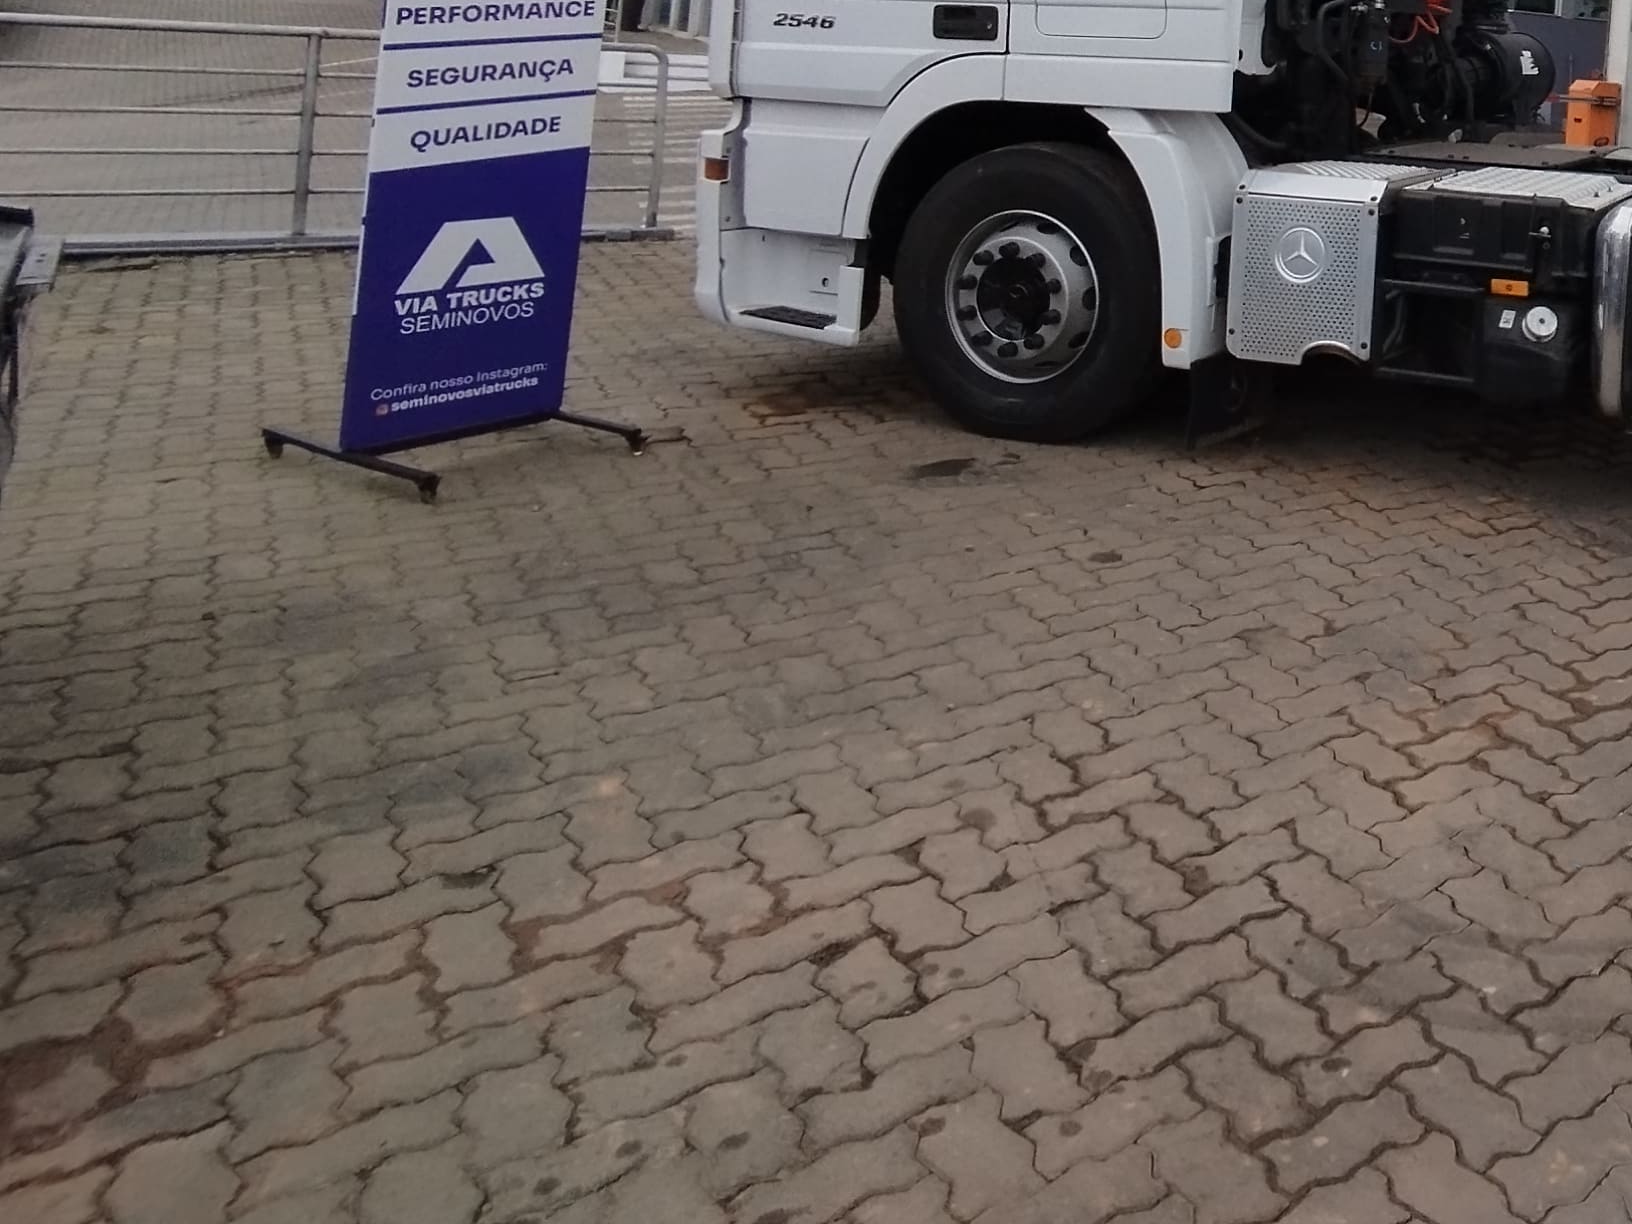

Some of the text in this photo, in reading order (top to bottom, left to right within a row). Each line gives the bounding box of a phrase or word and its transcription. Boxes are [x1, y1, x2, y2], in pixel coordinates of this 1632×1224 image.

[396, 0, 596, 26] PERFORMANCE
[773, 12, 836, 30] 2546
[407, 58, 575, 88] SEGURANÇA
[410, 116, 562, 153] QUALIDADE
[394, 282, 546, 317] VIA TRUCKS
[399, 301, 535, 335] SEMINOVOS
[370, 362, 549, 401] Confira nosso Instagram:
[391, 376, 539, 412] seminovosviatrucks
